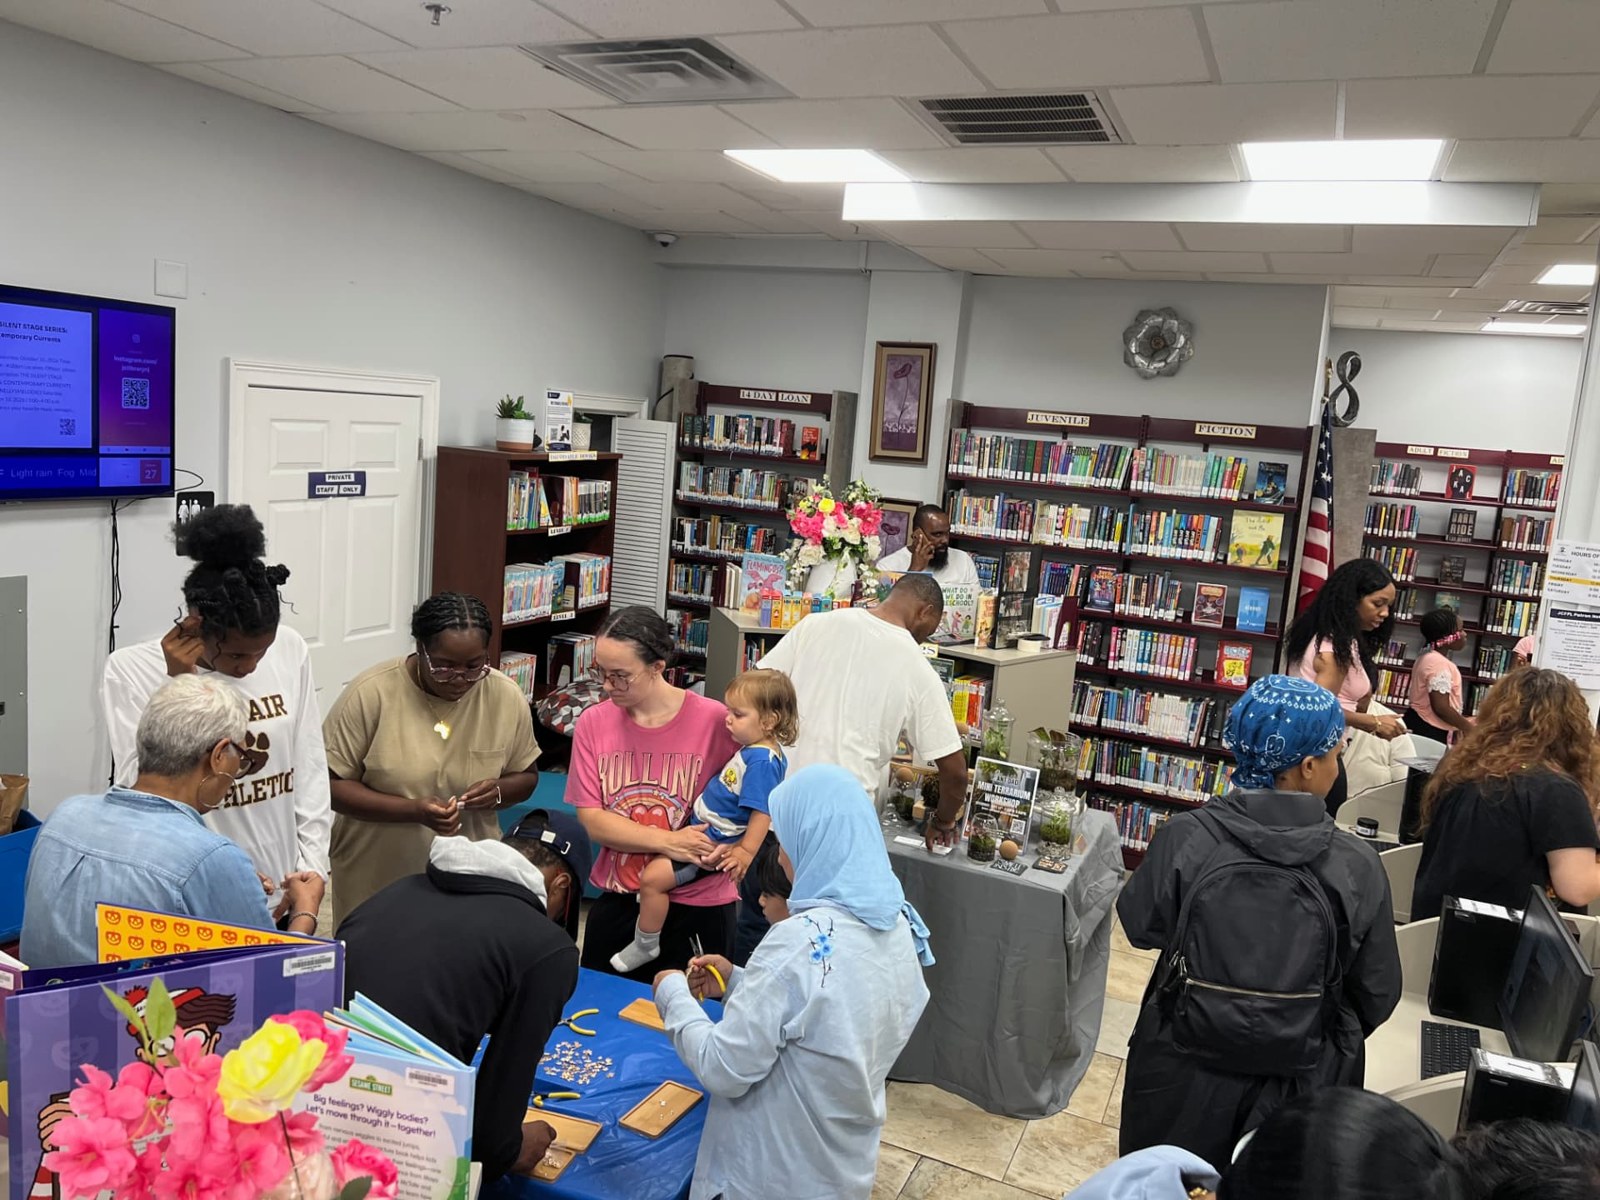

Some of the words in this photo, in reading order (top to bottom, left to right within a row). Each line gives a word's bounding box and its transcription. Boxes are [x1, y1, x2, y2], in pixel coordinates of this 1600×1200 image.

[23, 323, 43, 331] STAGE
[34, 334, 61, 343] Currents
[753, 391, 775, 400] DAY
[781, 393, 809, 403] LOAN
[1028, 413, 1089, 426] JUVENILE
[1198, 424, 1254, 436] FICTION
[1409, 447, 1432, 455] ADULT
[1439, 449, 1467, 457] FICTION
[11, 467, 32, 478] Light
[36, 468, 53, 477] rain
[58, 468, 75, 478] Fog
[79, 468, 97, 477] Mild
[144, 469, 157, 480] 27
[1450, 523, 1473, 536] RIDE
[977, 780, 993, 792] MINI
[994, 784, 1031, 800] TERRARIUM
[984, 792, 1021, 806] WORKSHOP
[351, 1078, 371, 1090] SESAME
[372, 1081, 392, 1094] STREET
[313, 1093, 327, 1106] Big
[328, 1095, 364, 1112] feelings?
[366, 1104, 395, 1119] Wiggly
[396, 1109, 429, 1124] bodies?
[306, 1103, 324, 1116] Let's
[326, 1109, 348, 1119] move
[350, 1111, 382, 1127] through
[384, 1117, 390, 1127] it
[397, 1122, 436, 1138] together!
[355, 1131, 375, 1141] wiggles
